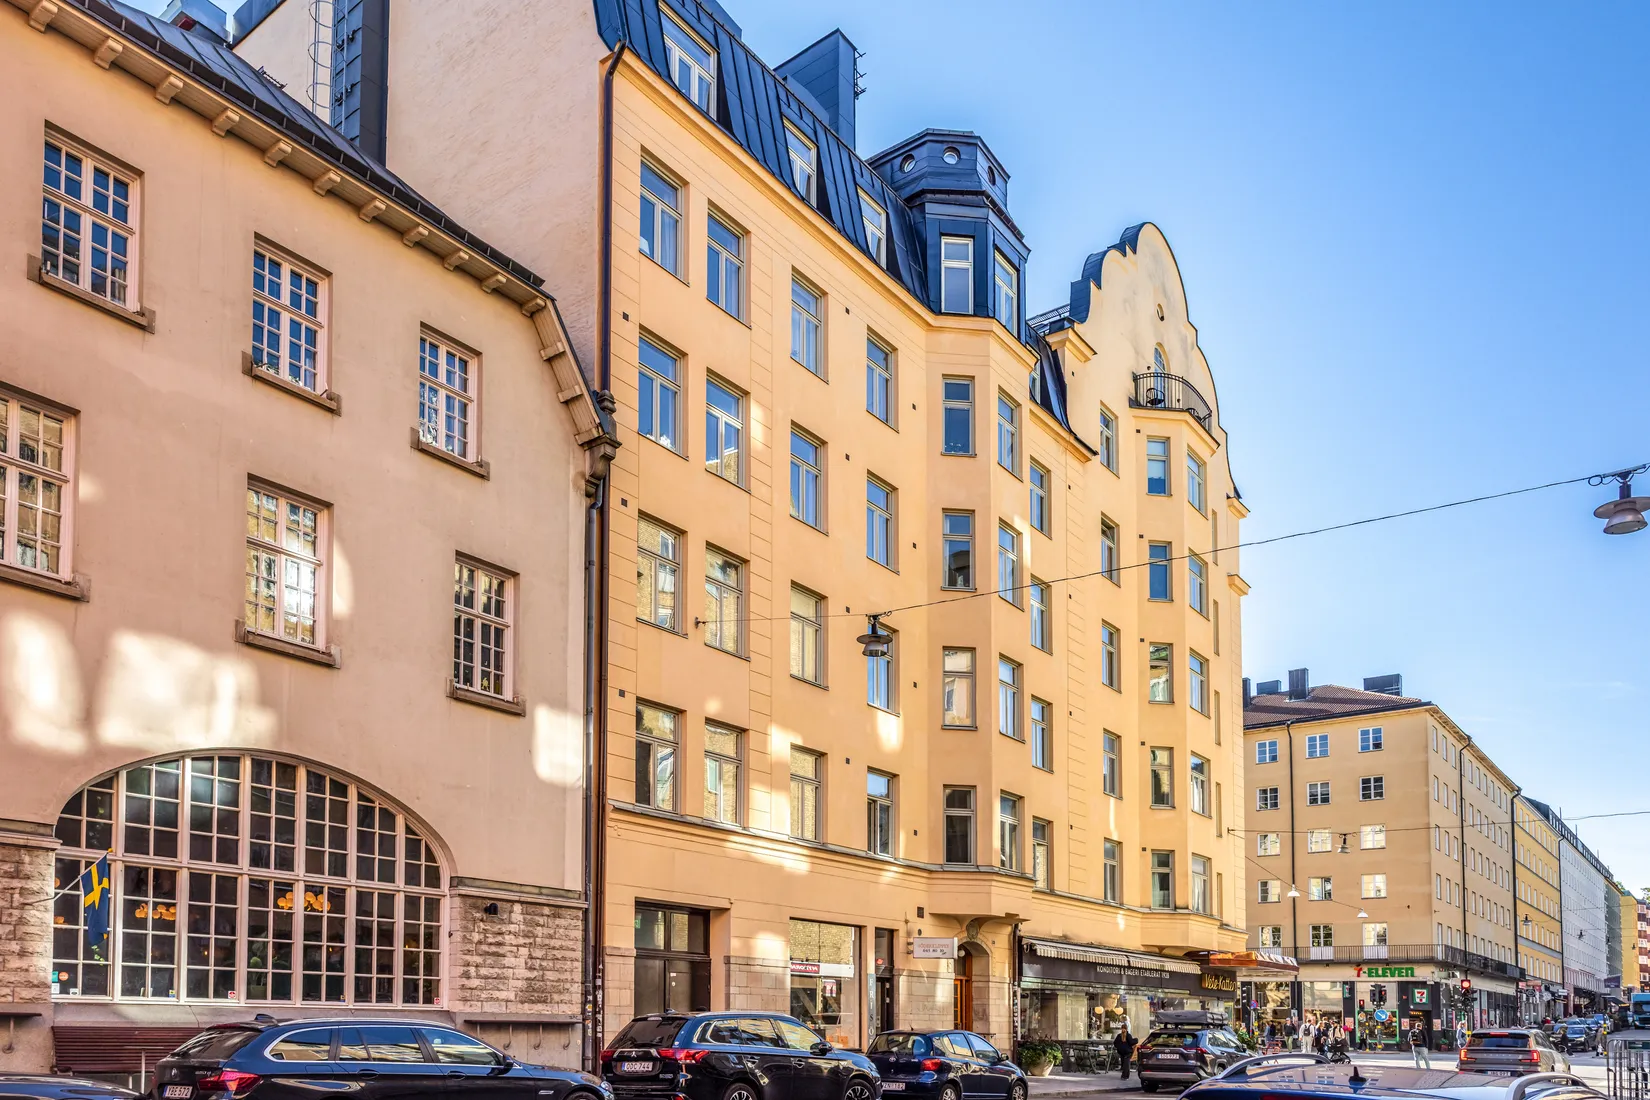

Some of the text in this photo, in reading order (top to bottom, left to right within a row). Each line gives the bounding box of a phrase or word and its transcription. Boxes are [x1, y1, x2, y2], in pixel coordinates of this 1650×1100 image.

[1096, 965, 1120, 974] KONDITORI
[1125, 968, 1140, 976] BAGERI
[1140, 970, 1160, 978] ETABLERAT
[1354, 966, 1415, 978] 7-ELEVEN
[178, 1086, 190, 1096] 572
